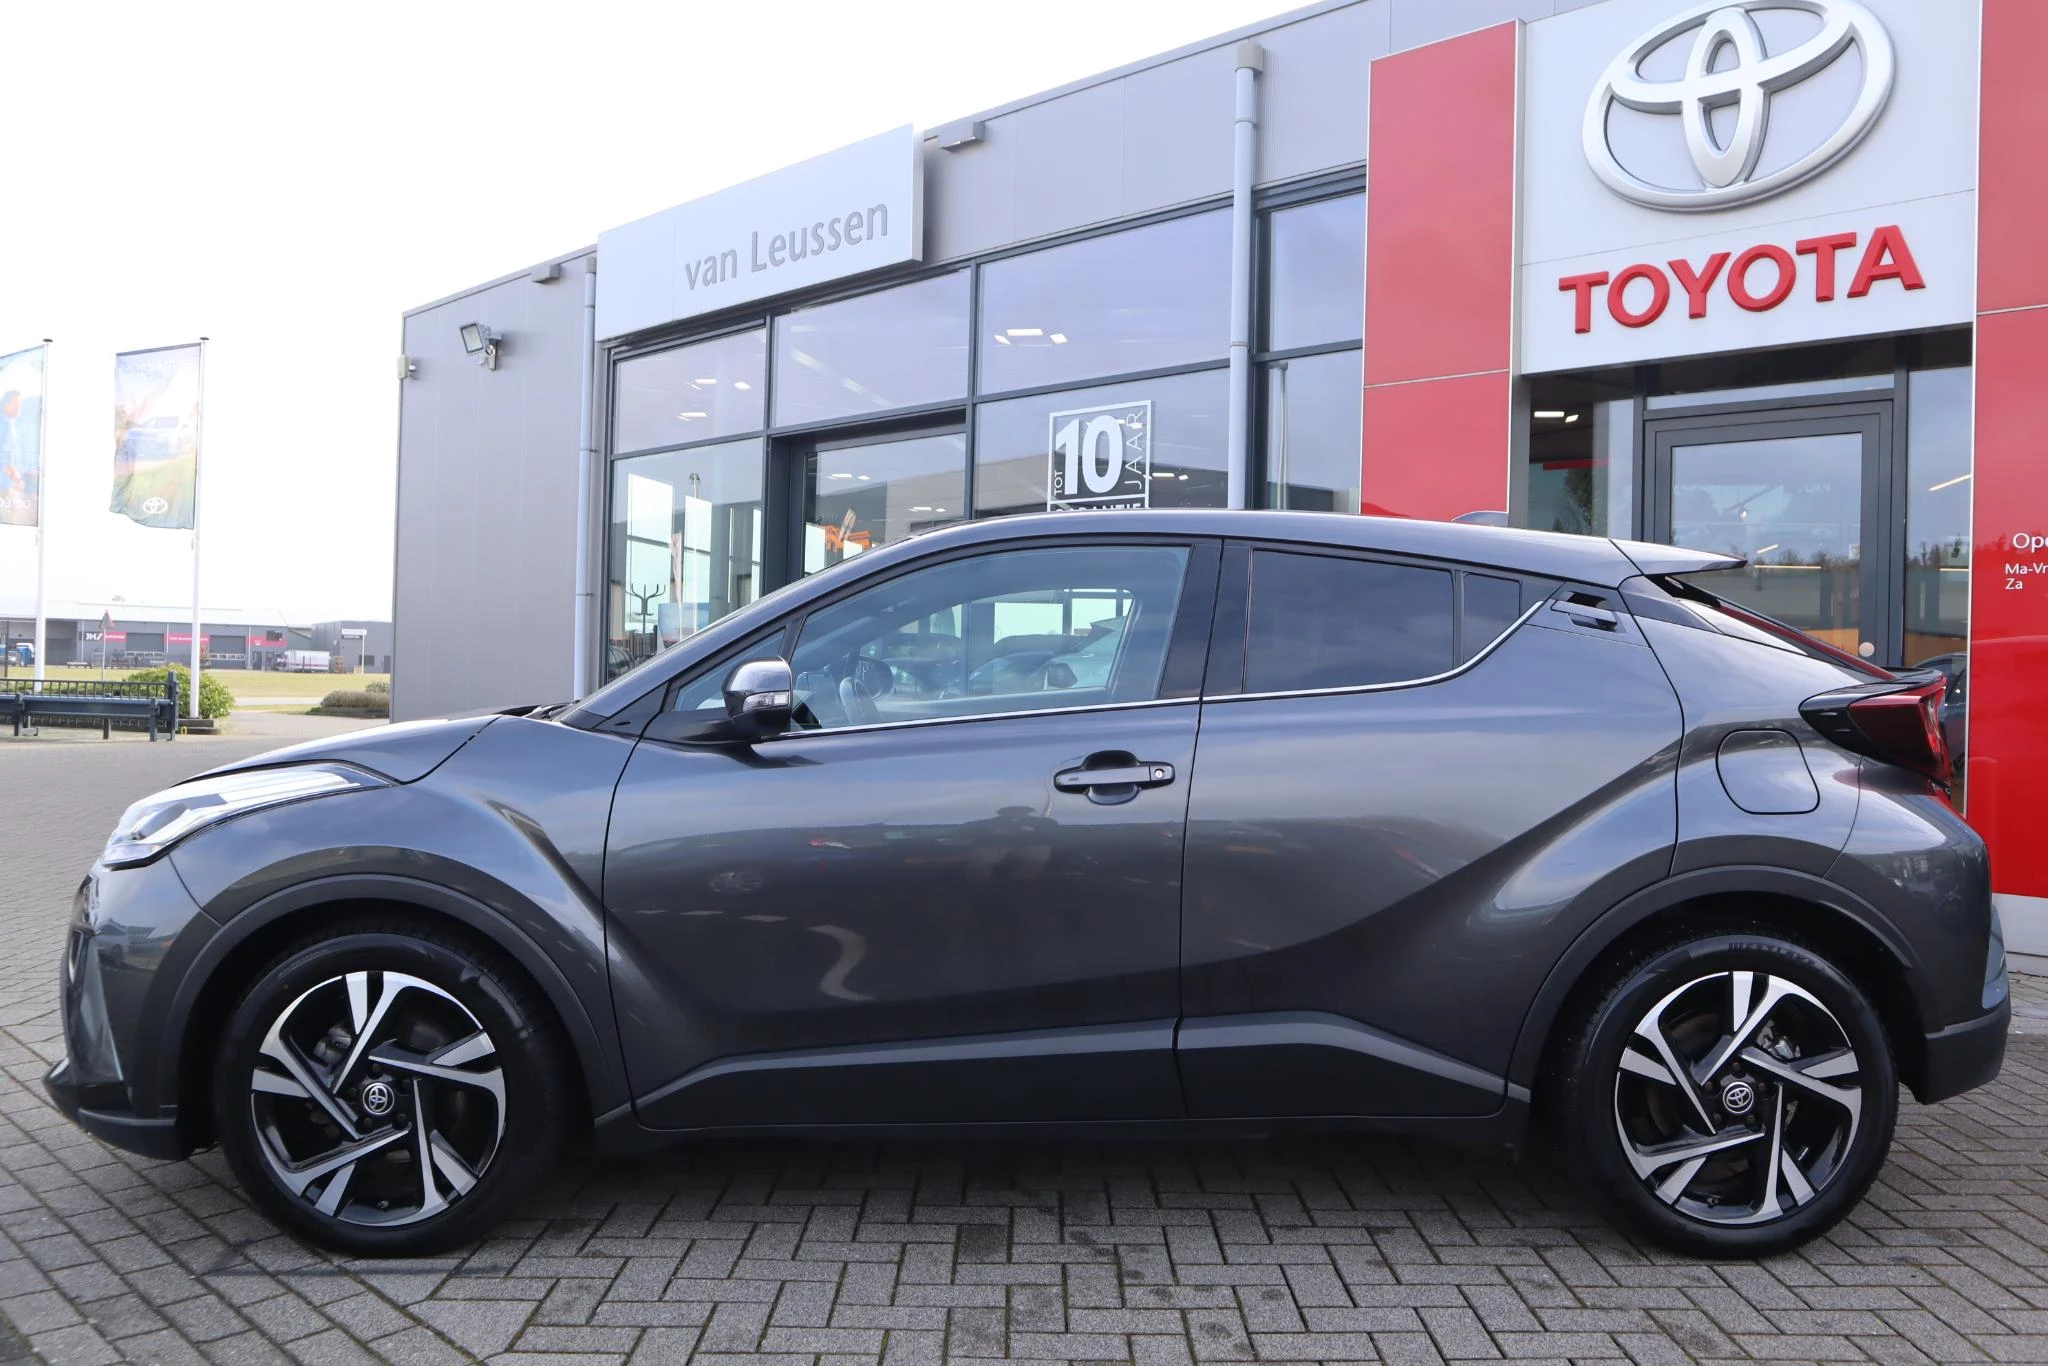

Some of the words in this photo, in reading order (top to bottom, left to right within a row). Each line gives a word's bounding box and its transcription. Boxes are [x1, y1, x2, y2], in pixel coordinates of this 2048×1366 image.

[685, 247, 737, 290] van
[752, 204, 888, 272] Leussen
[1558, 225, 1926, 334] TOYOTA
[1054, 470, 1062, 496] TOT
[1055, 415, 1123, 494] 10
[1124, 410, 1144, 490] JAAR
[2013, 533, 2048, 553] Op
[2005, 578, 2023, 589] Za
